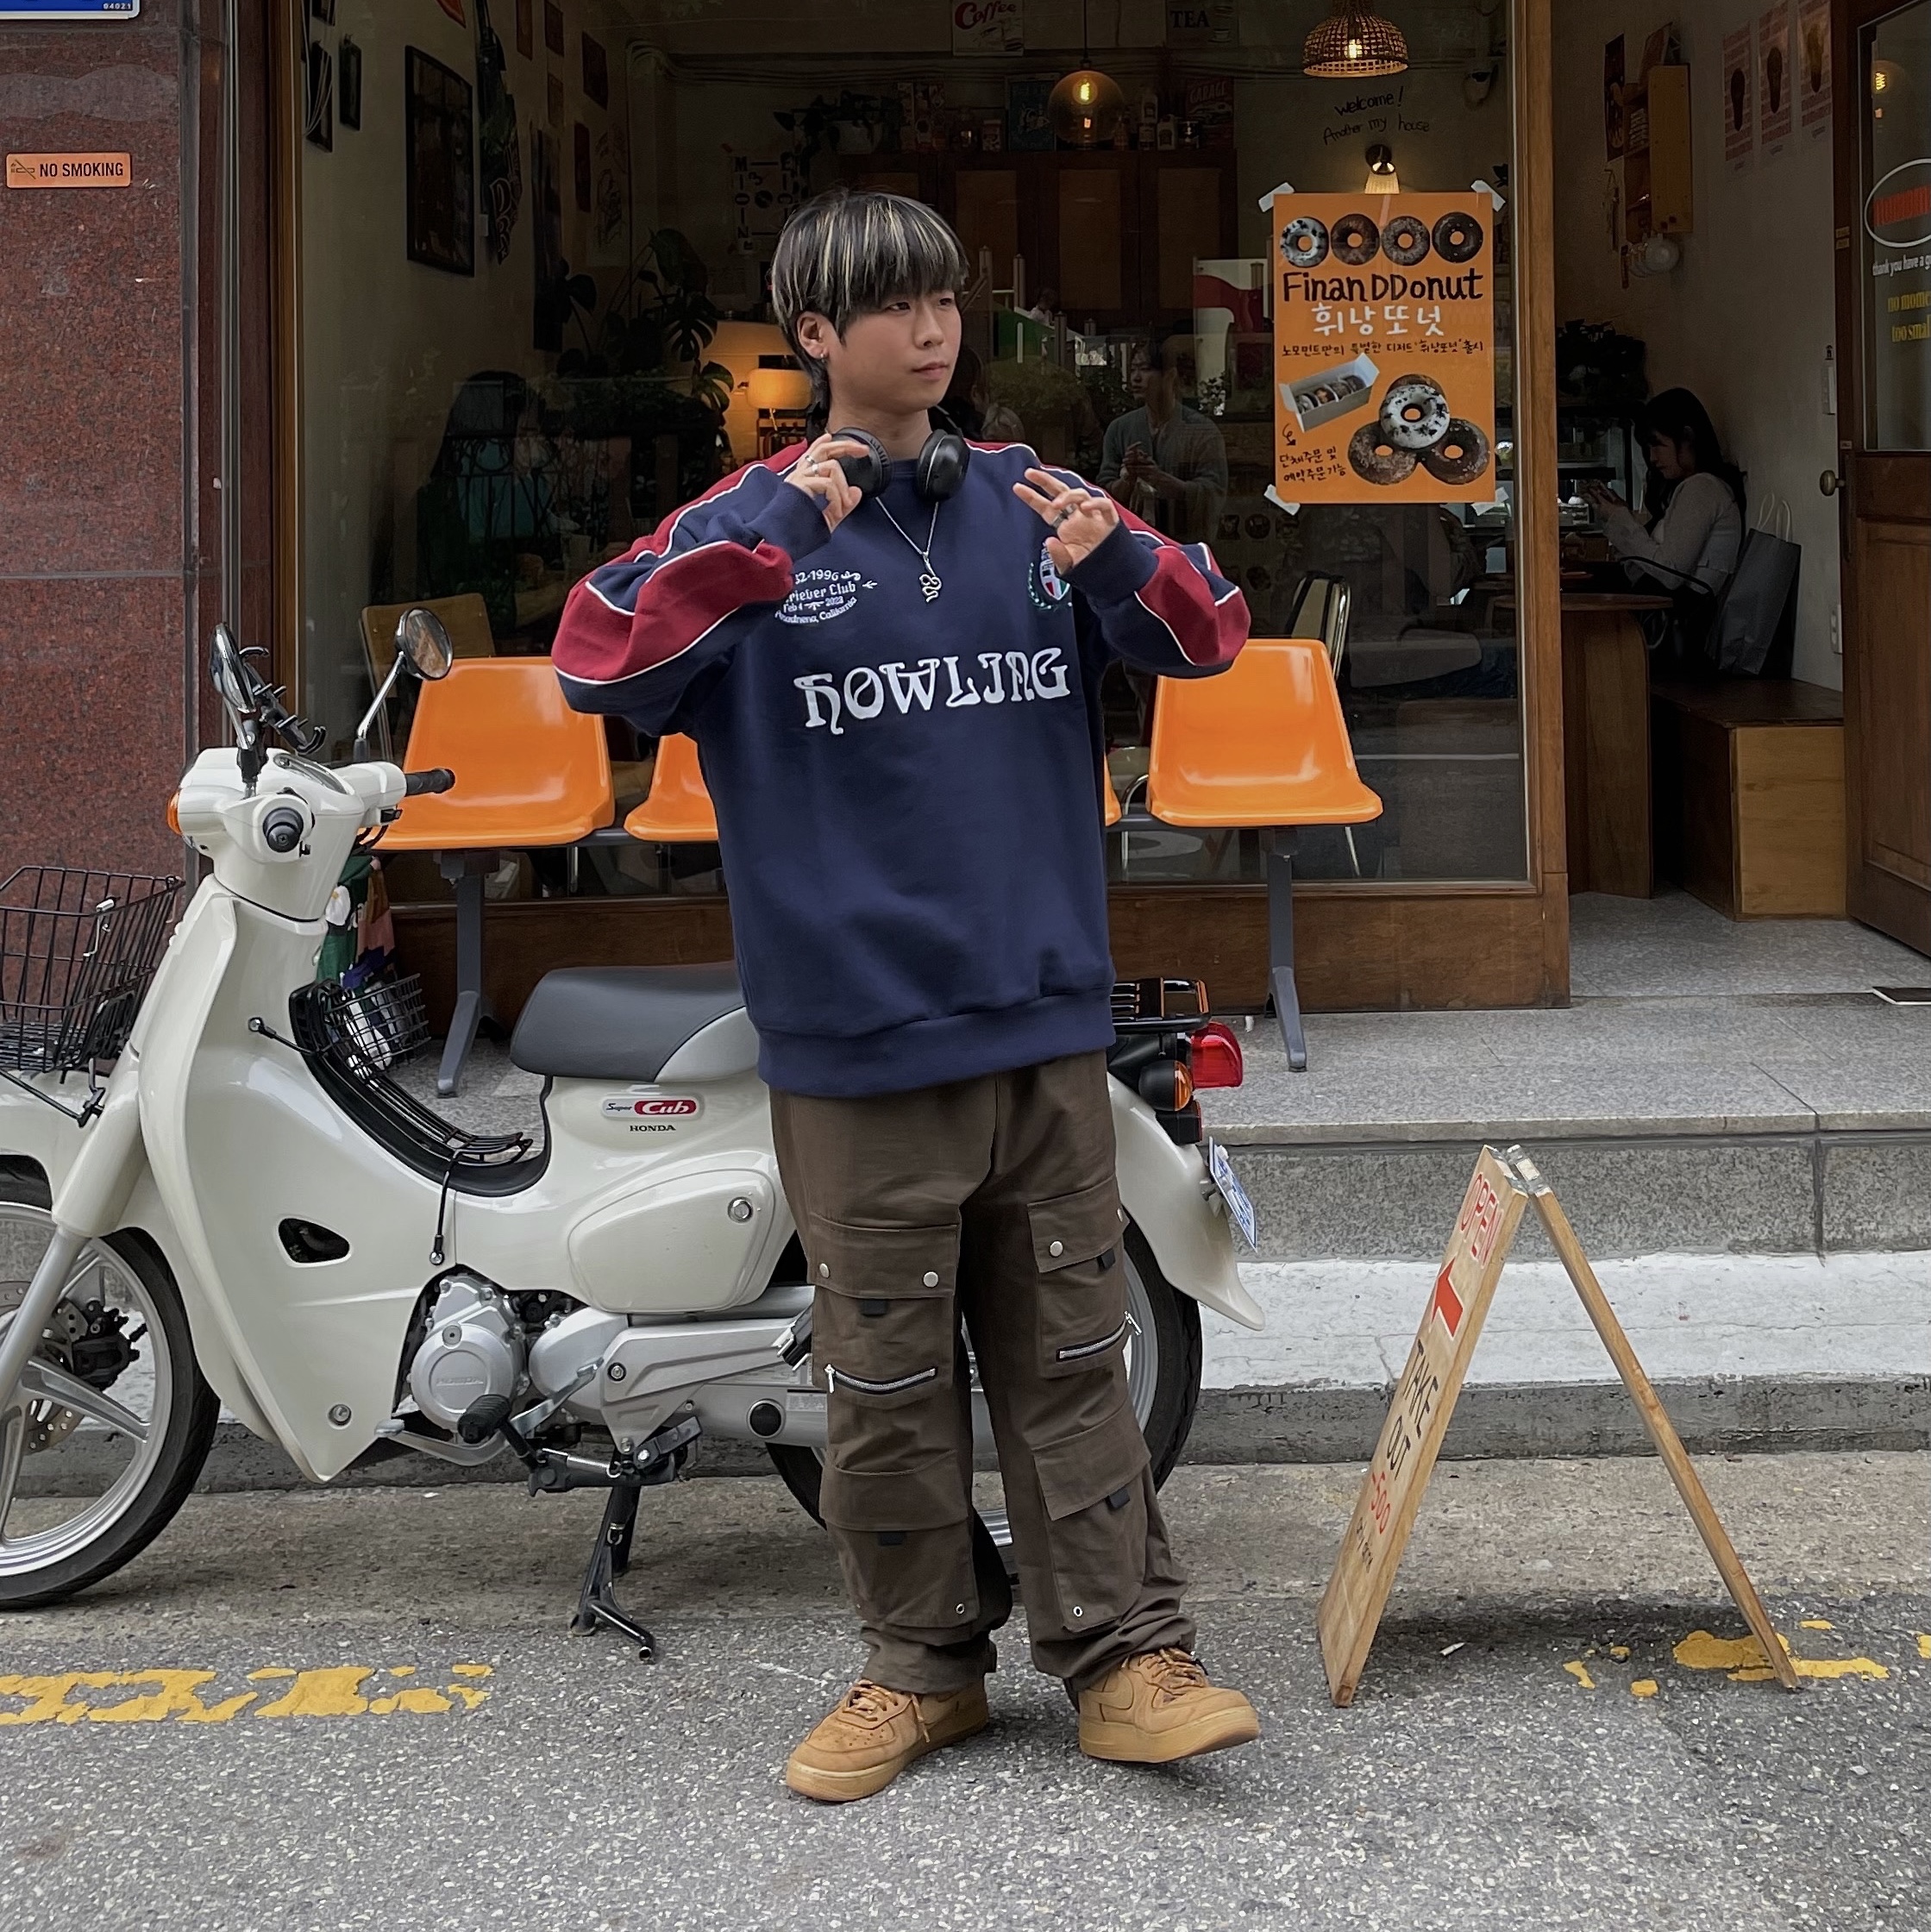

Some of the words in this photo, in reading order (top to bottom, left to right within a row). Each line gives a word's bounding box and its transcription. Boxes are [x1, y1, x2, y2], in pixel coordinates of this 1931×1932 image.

[955, 1, 1017, 29] Coffee
[1170, 10, 1210, 28] TEA
[1190, 81, 1226, 104] GARAGE
[1368, 117, 1387, 132] my
[1398, 113, 1430, 132] house
[40, 163, 58, 178] NO
[62, 162, 124, 178] SMOKING
[1890, 260, 1903, 277] you
[1903, 254, 1919, 270] have
[786, 587, 827, 603] riever
[829, 580, 856, 596] Club
[793, 647, 1071, 735] HOWLING
[605, 1102, 633, 1112] Super
[642, 1101, 690, 1113] Cub
[1460, 1171, 1504, 1270] OPEN
[1402, 1338, 1439, 1440] TAKE
[1386, 1414, 1411, 1482] OUT
